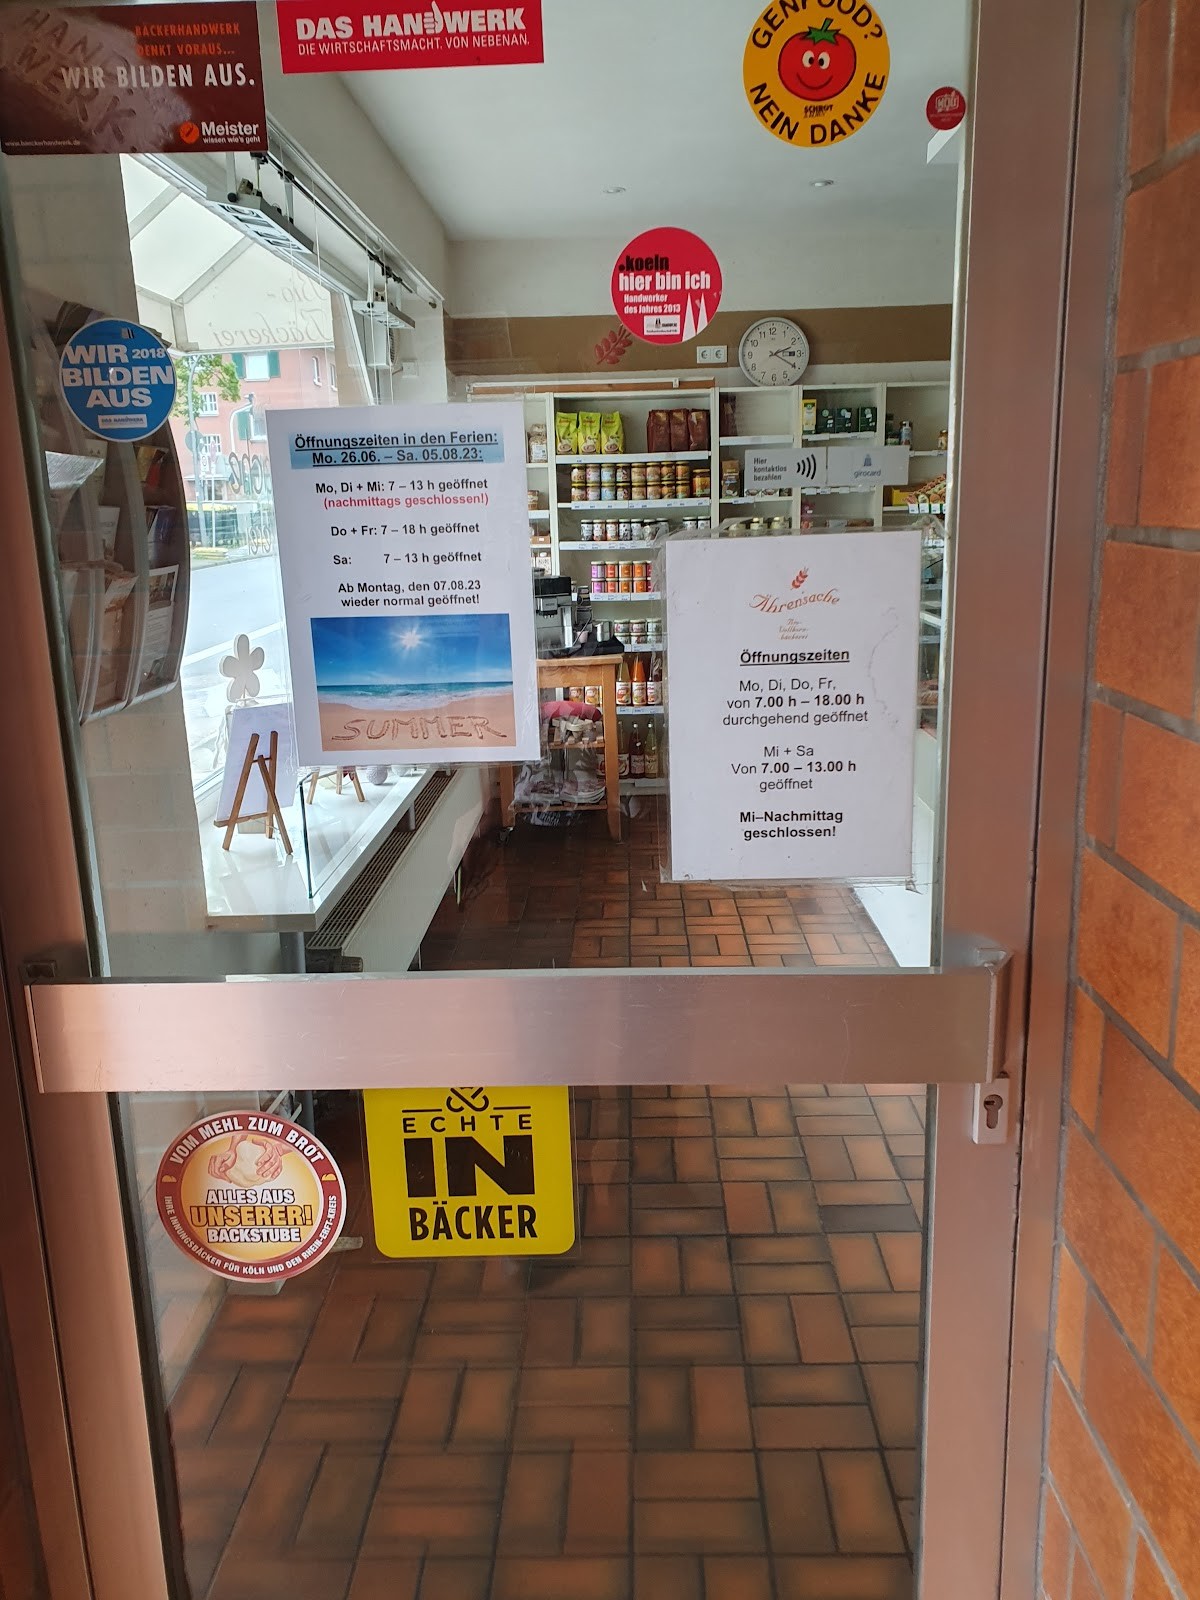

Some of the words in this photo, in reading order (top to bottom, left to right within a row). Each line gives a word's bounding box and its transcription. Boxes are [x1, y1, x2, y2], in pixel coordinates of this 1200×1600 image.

[135, 21, 240, 37] BÄCKERHANDWERK
[296, 15, 352, 40] DAS
[136, 44, 171, 57] DENKT
[177, 43, 235, 56] VORAUS...
[298, 43, 316, 55] DIE
[319, 37, 442, 55] WIRTSCHAFTSMACHT.
[446, 36, 469, 48] VON
[472, 33, 529, 48] NEBENAN.
[61, 66, 105, 89] WIR
[117, 64, 193, 88] BILDEN
[205, 63, 255, 86] AUS.
[750, 82, 799, 140] NEIN
[811, 72, 885, 144] DANKE
[201, 121, 259, 136] Meister
[228, 136, 244, 144] wie's
[244, 136, 261, 146] geht
[618, 254, 669, 272] .koeln
[619, 272, 652, 291] hier
[655, 272, 681, 290] bin
[685, 271, 710, 289] ich
[624, 305, 637, 314] des
[639, 304, 662, 314] Jahres
[64, 344, 129, 366] WIR
[132, 348, 166, 359] 2018
[62, 365, 174, 387] BILDEN
[86, 388, 152, 408] AUS
[294, 433, 399, 449] Öffnungszeiten
[403, 434, 416, 445] in
[420, 432, 446, 445] den
[450, 431, 498, 443] Ferien:
[312, 452, 337, 464] Mo.
[341, 451, 381, 463] 26.06.
[396, 450, 418, 462] Sa.
[422, 448, 483, 461] 05.08.23:
[753, 457, 767, 465] Hier
[753, 465, 787, 473] kontaktlos
[854, 469, 881, 479] girocard
[753, 473, 782, 482] bezahlen
[315, 483, 337, 495] Mo,
[340, 482, 353, 493] Di
[367, 481, 385, 492] Mi:
[388, 481, 395, 491] 7
[410, 480, 423, 491] 13
[427, 480, 434, 490] h
[438, 479, 488, 492] geöffnet
[323, 496, 401, 510] (nachmittags
[404, 493, 489, 508] geschlossen!)
[331, 526, 347, 536] Do
[361, 525, 377, 535] Fr:
[381, 525, 387, 535] 7
[402, 524, 415, 534] 18
[419, 524, 426, 534] h
[430, 523, 480, 536] geöffnet
[333, 554, 351, 565] Sa:
[383, 554, 390, 564] 7
[404, 552, 418, 563] 13
[422, 552, 429, 562] h
[433, 552, 482, 564] geöffnet
[338, 583, 354, 593] Ab
[357, 582, 405, 595] Montag,
[408, 581, 430, 592] den
[433, 580, 481, 591] 07.08.23
[341, 596, 379, 607] wieder
[383, 595, 424, 606] normal
[428, 594, 480, 608] geöffnet!
[740, 649, 850, 664] Öffnungszeiten
[739, 679, 764, 693] Mo,
[768, 678, 786, 691] Di,
[791, 678, 812, 691] Do,
[727, 699, 750, 709] von
[755, 696, 783, 708] 7.00
[788, 695, 797, 707] h
[814, 694, 851, 706] 18.00
[856, 693, 865, 705] h
[722, 713, 810, 727] durchgehend
[813, 711, 868, 725] geöffnet
[332, 716, 507, 740] SUMMER
[763, 745, 779, 757] Mi
[796, 746, 814, 757] Sa
[731, 763, 757, 775] Von
[761, 762, 790, 774] 7.00
[807, 761, 844, 773] 13.00
[848, 761, 857, 772] h
[759, 778, 813, 792] geöffnet
[743, 826, 836, 842] geschlossen!
[403, 1113, 532, 1134] ECHTE
[170, 1134, 199, 1165] VOM
[198, 1117, 243, 1139] MEHL
[248, 1117, 284, 1136] ZUM
[286, 1128, 324, 1163] BROT
[404, 1135, 535, 1198] IN
[206, 1189, 258, 1204] ALLES
[260, 1189, 295, 1204] AUS
[190, 1205, 314, 1227] UNSERER!
[408, 1201, 538, 1240] BÄCKER
[164, 1196, 174, 1215] IHRE
[170, 1215, 222, 1267] INNUNGSBÄCKER
[223, 1262, 240, 1273] FÜR
[243, 1265, 264, 1275] KÖLN
[267, 1264, 284, 1275] UND
[286, 1255, 303, 1269] DEN
[301, 1195, 337, 1260] RHEIN-ERFT-KREIS
[207, 1228, 301, 1243] BACKSTUBE
